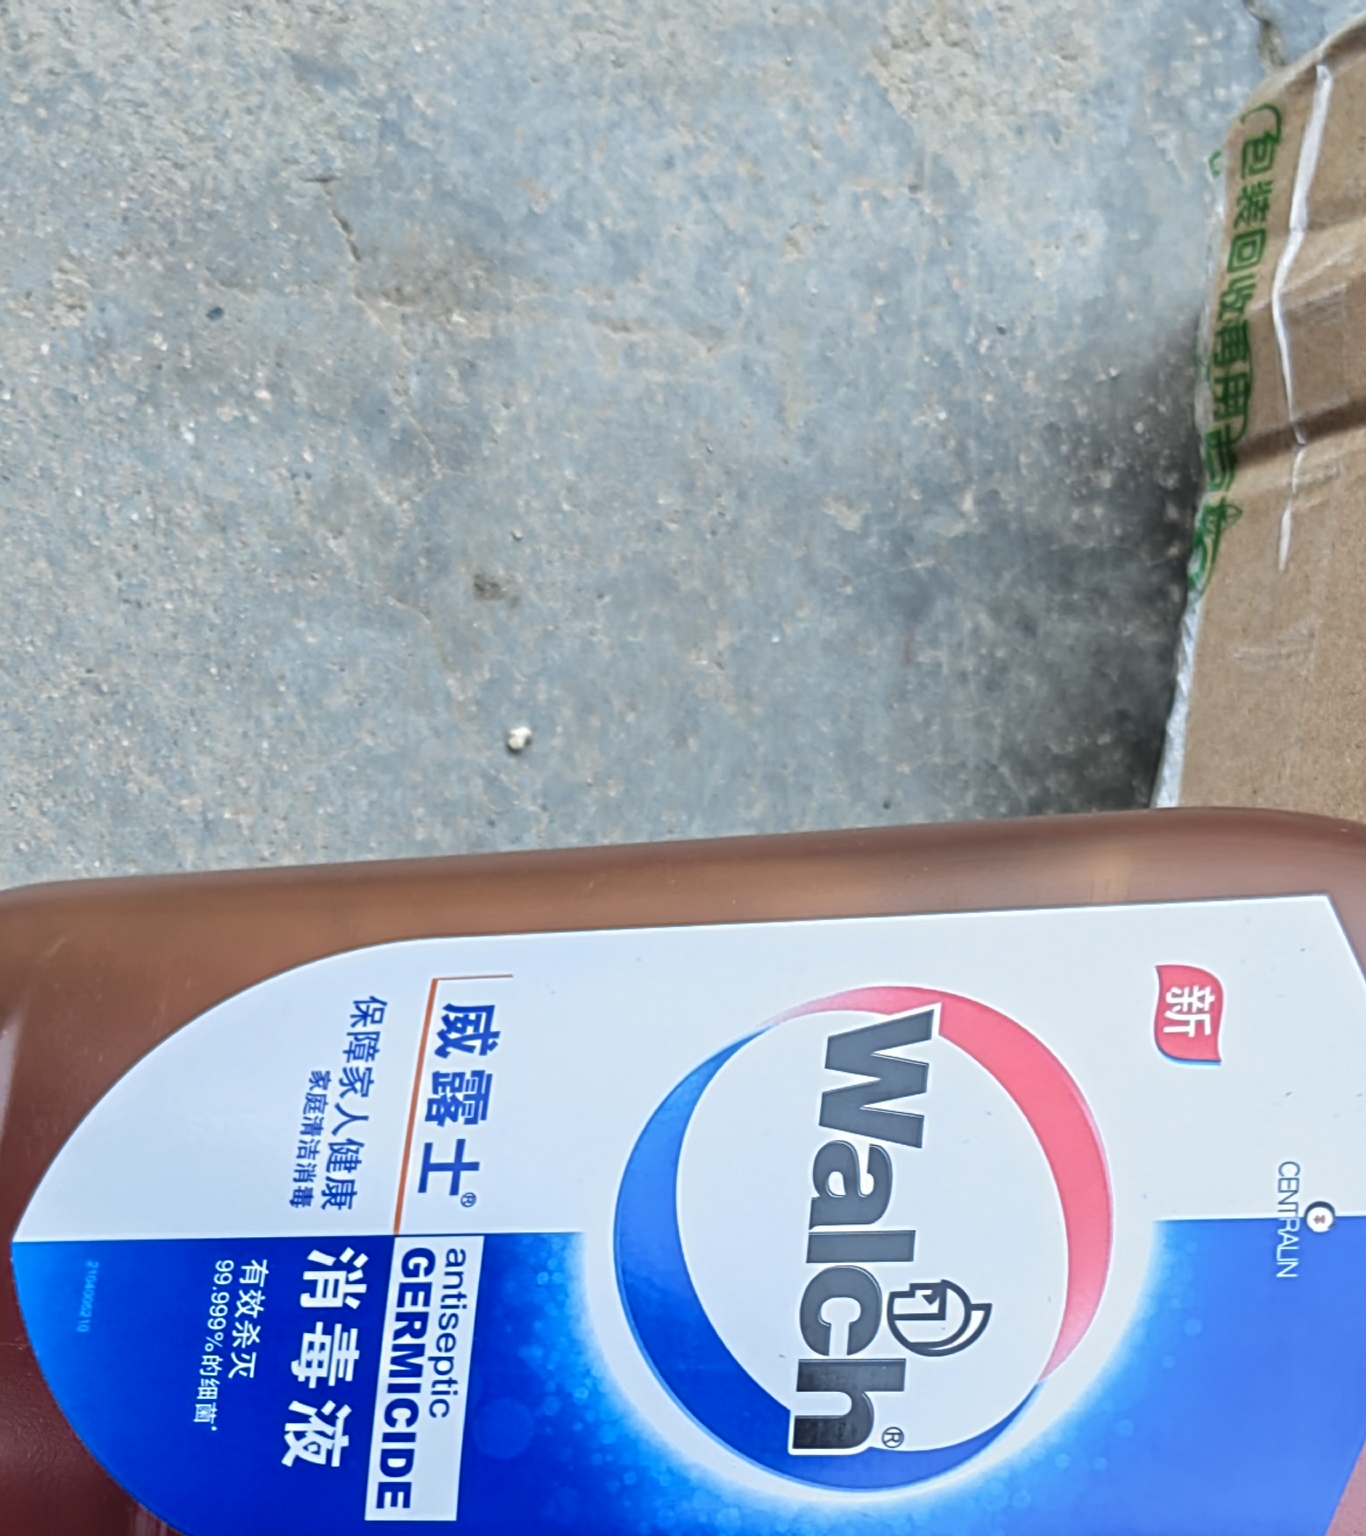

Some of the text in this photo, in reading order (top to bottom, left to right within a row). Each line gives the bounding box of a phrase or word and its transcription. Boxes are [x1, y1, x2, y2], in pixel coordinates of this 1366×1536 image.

[418, 1002, 501, 1197] 威露士
[1162, 985, 1215, 1038] 新
[290, 1070, 333, 1209] 家庭清洁消毒
[320, 995, 389, 1211] 保障家人健康
[791, 1009, 935, 1451] Walch
[1276, 1161, 1301, 1278] CENTRALIN
[228, 1259, 269, 1380] 有效杀灭
[281, 1247, 370, 1468] 消毒液
[376, 1247, 437, 1510] GERMICIDE
[428, 1248, 470, 1418] antiseptic
